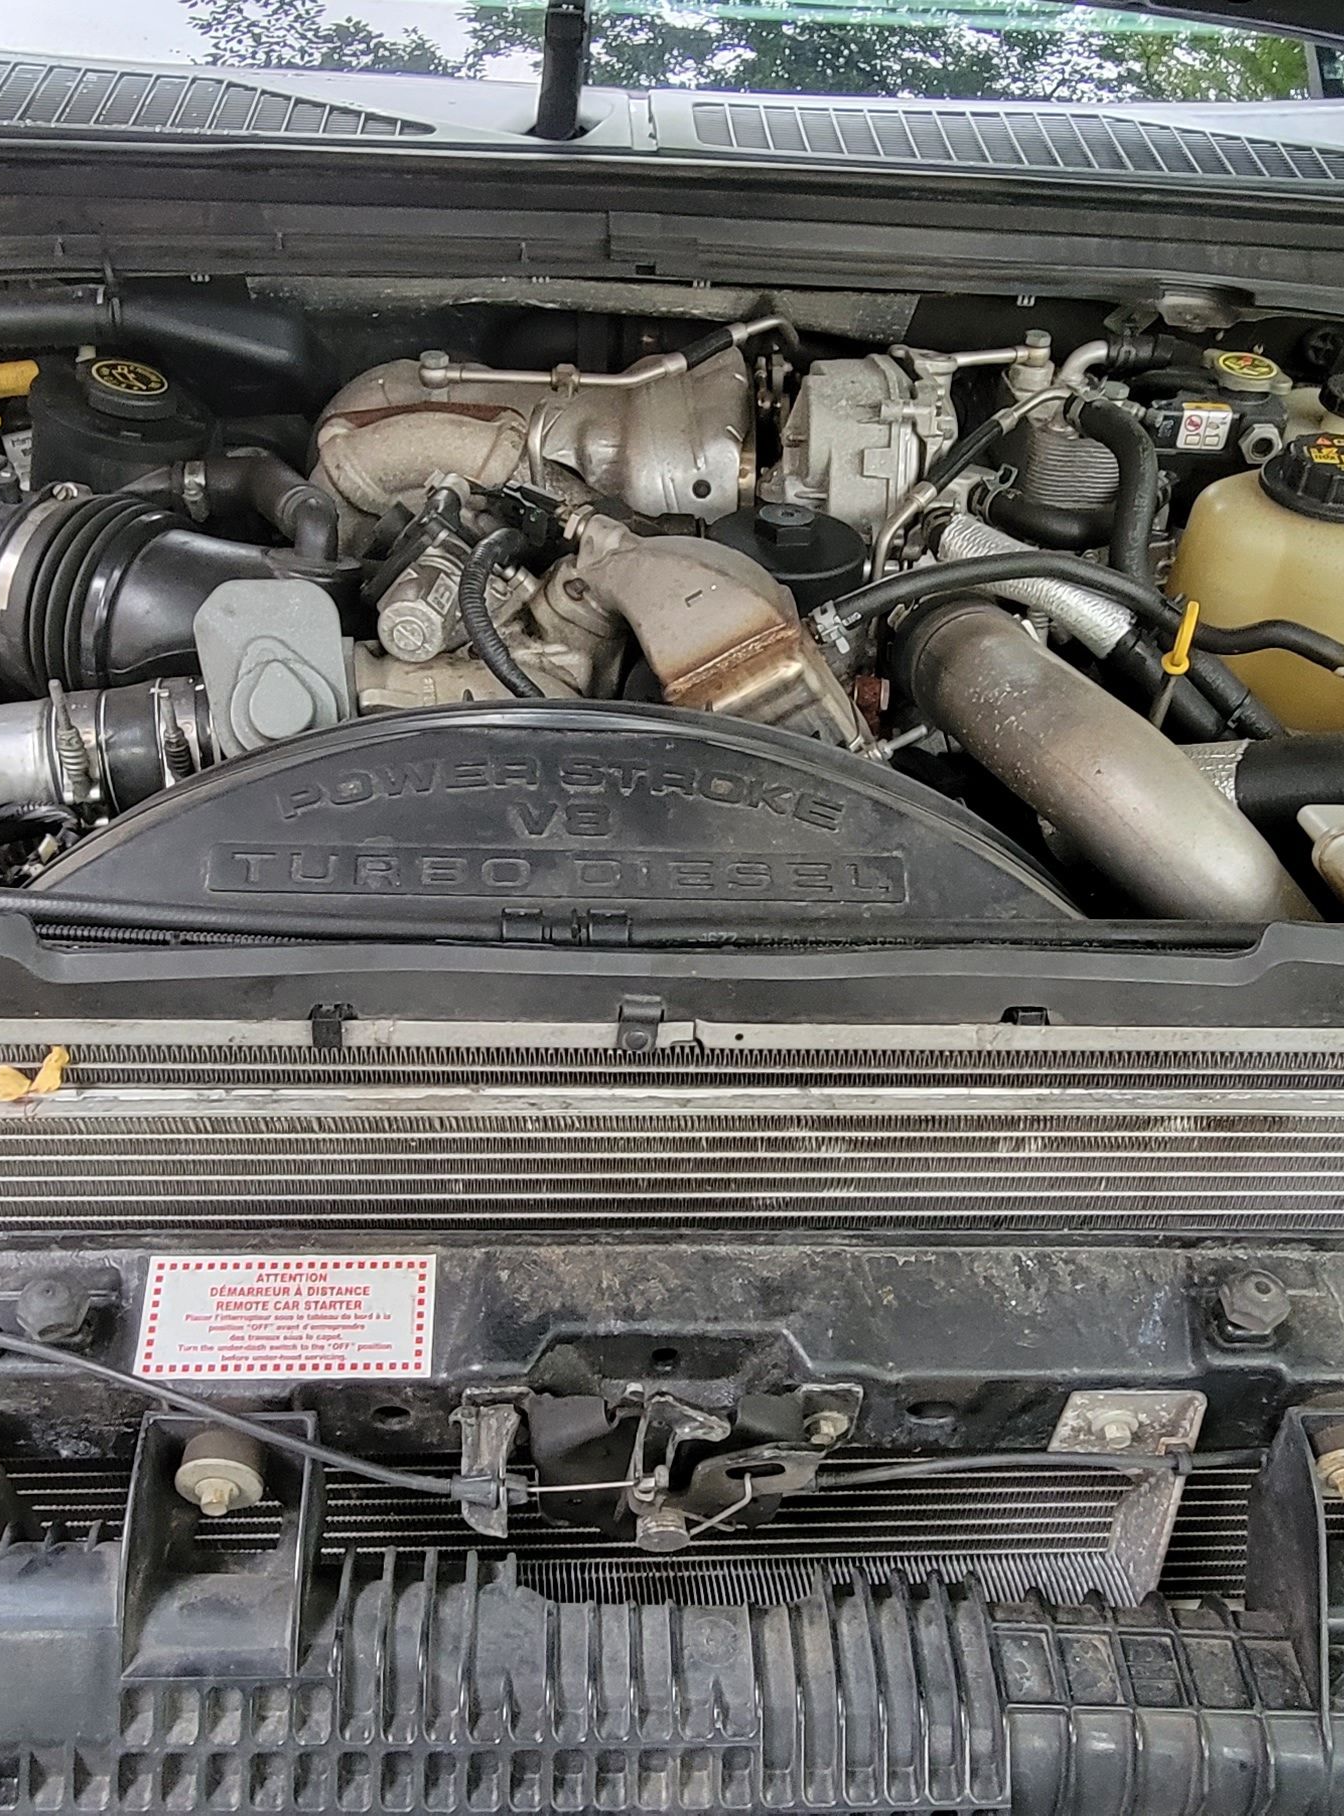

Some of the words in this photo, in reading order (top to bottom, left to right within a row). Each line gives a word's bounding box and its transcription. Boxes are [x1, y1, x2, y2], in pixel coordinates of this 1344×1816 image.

[276, 756, 540, 820] POWER
[560, 756, 845, 832] STROKE
[511, 800, 613, 838] V8
[233, 852, 531, 887] TURBO
[573, 858, 891, 893] DIESEL
[256, 1273, 328, 1283] ATTENTION
[210, 1286, 290, 1297] DÉMARREUR
[294, 1286, 303, 1296] À
[307, 1286, 370, 1296] DISTANCE
[216, 1301, 269, 1311] REMOTE
[274, 1301, 300, 1311] CAR
[304, 1301, 362, 1311] STARTER
